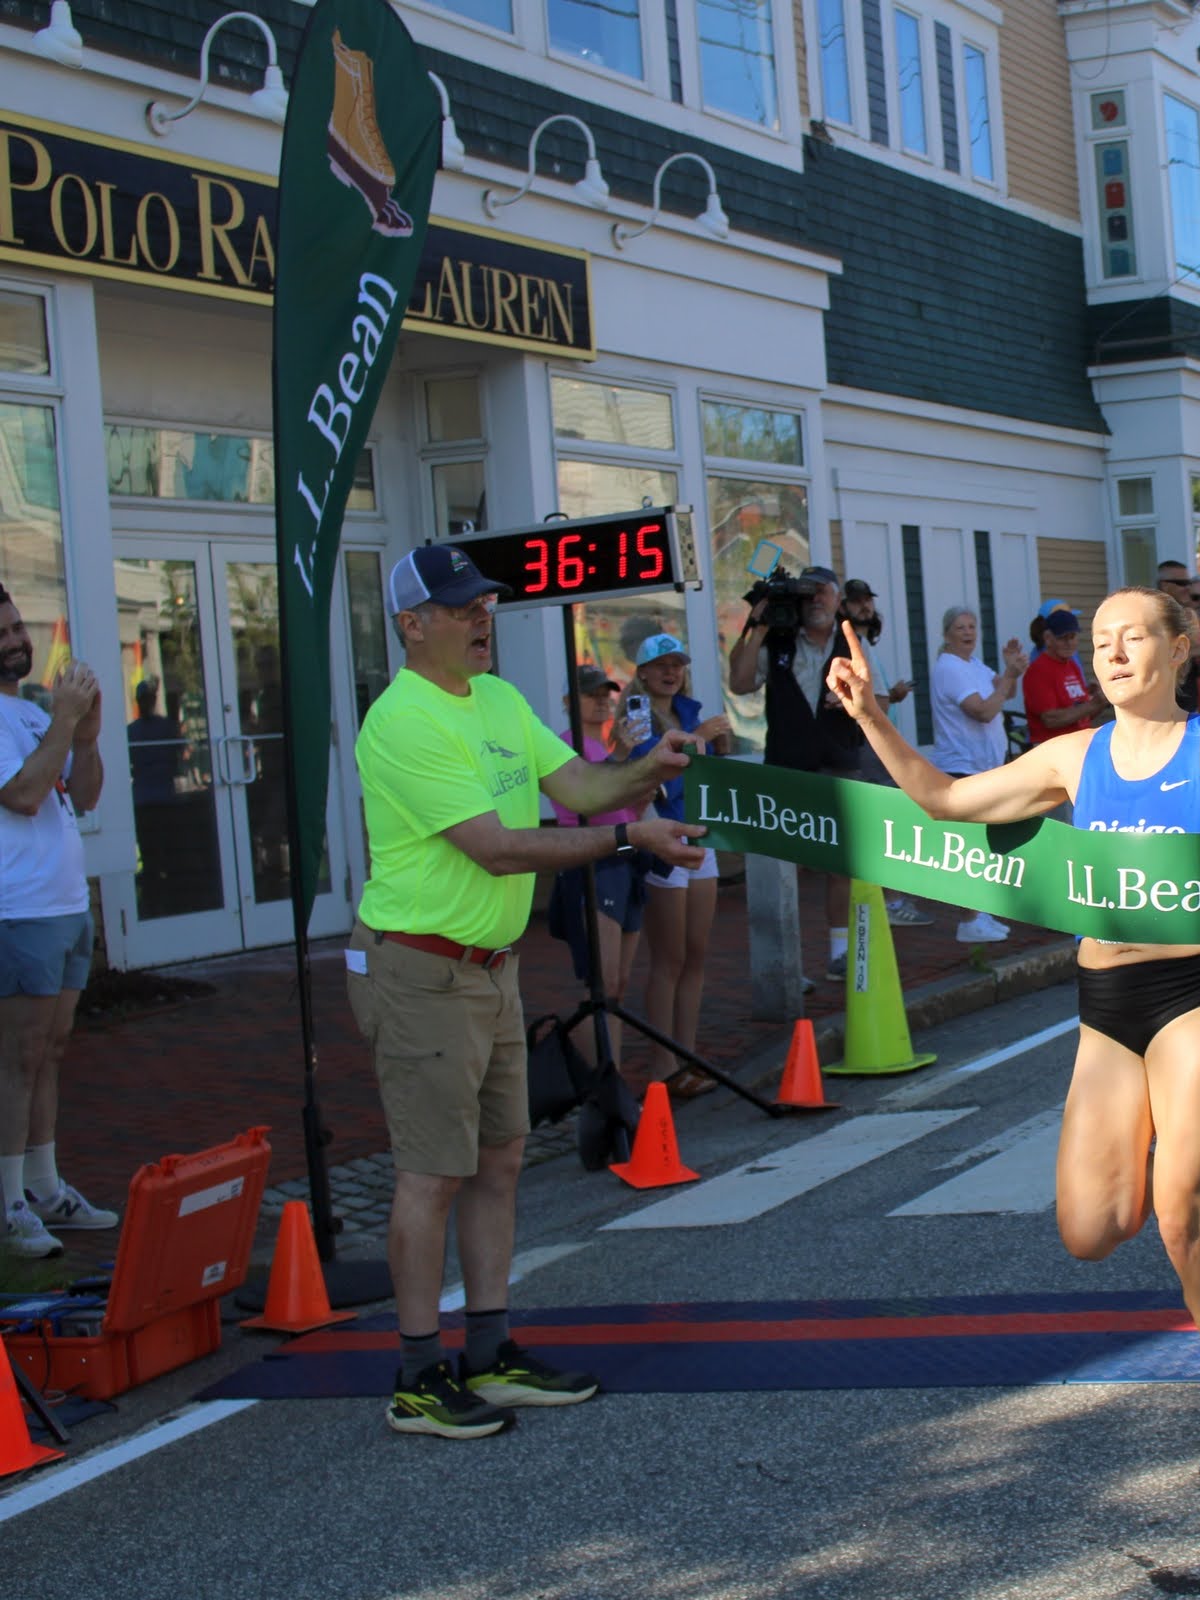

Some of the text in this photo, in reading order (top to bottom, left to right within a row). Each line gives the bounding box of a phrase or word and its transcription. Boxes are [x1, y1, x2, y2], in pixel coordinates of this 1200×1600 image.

[0, 130, 181, 272] POLO
[525, 524, 663, 592] 36:15
[699, 784, 839, 845] L.L.Bean
[884, 819, 1026, 888] L.L.Bean
